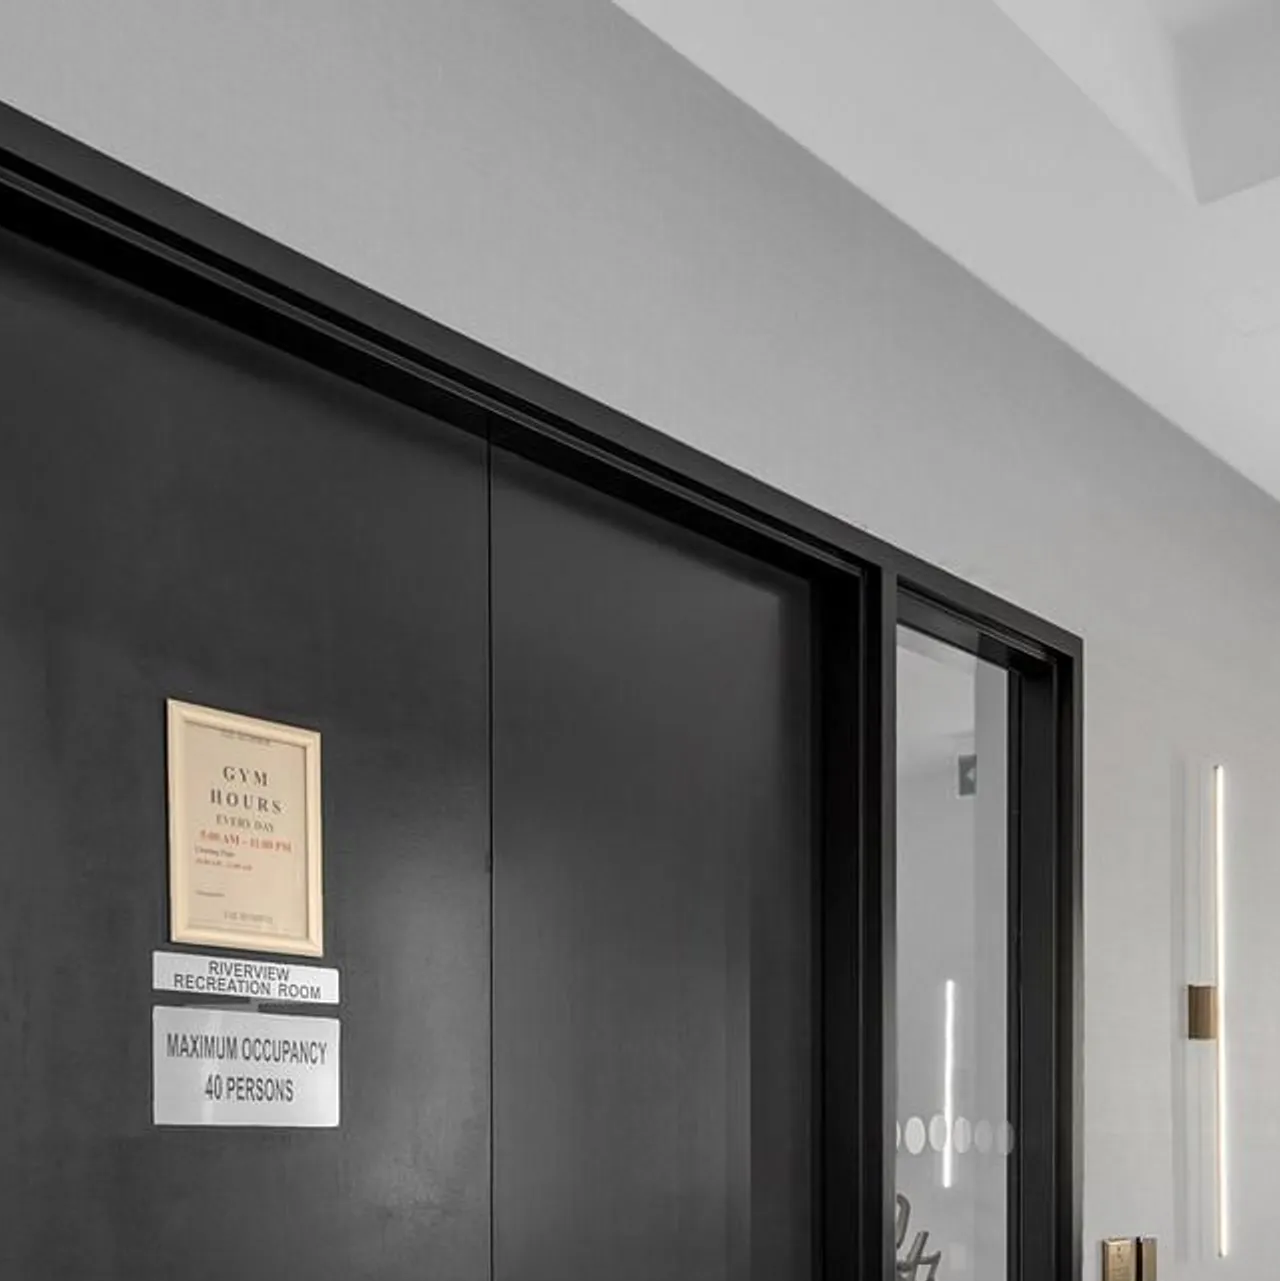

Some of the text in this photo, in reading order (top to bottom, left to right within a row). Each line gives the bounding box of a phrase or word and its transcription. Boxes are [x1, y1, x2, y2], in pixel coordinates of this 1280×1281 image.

[222, 765, 267, 787] GYM
[210, 788, 283, 815] HOURS
[216, 814, 252, 830] EVERY
[208, 960, 290, 982] RIVERVIEW
[174, 973, 322, 999] RECREATION ROOM
[166, 1033, 328, 1065] MAXIMUM OCCUPANCY
[205, 1074, 294, 1103] 40 PERSONS
